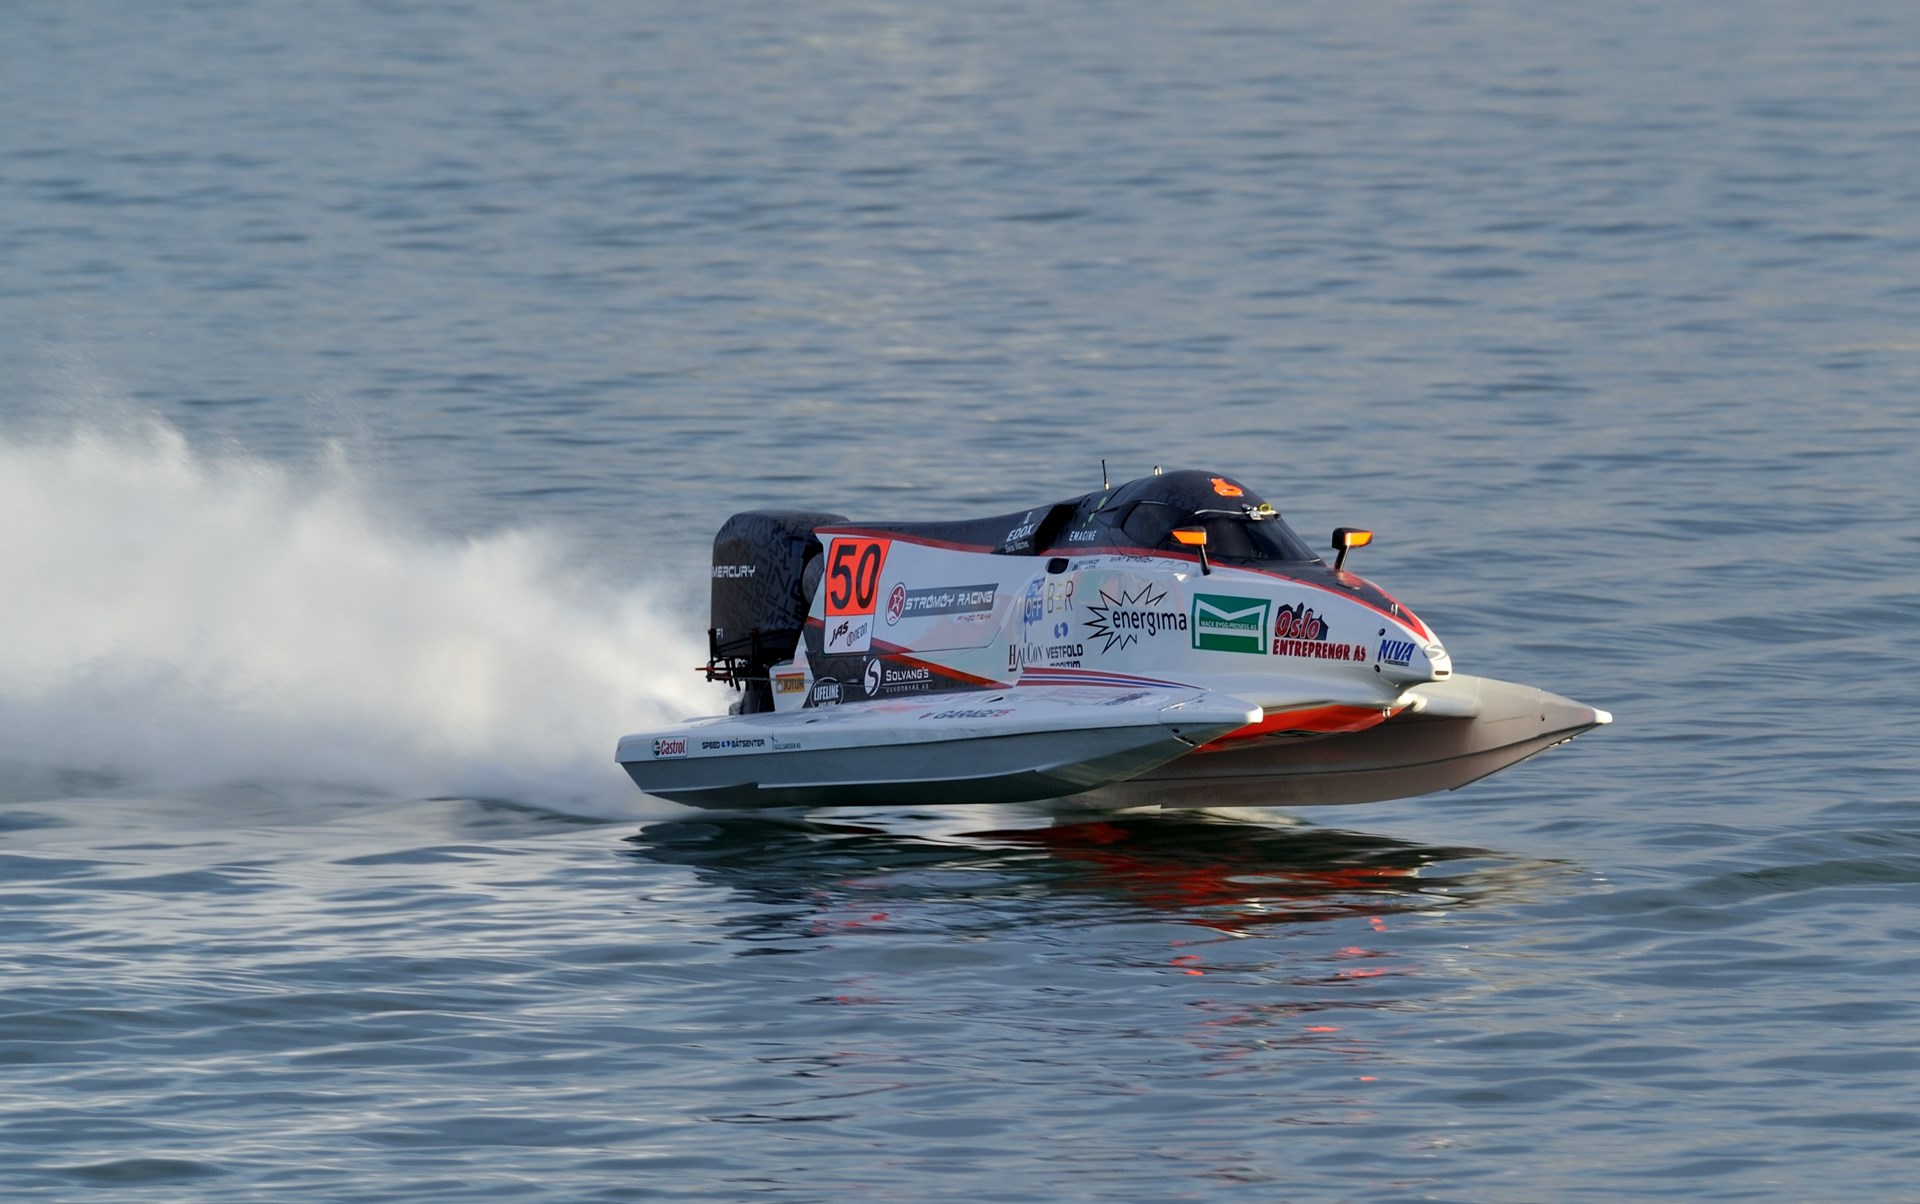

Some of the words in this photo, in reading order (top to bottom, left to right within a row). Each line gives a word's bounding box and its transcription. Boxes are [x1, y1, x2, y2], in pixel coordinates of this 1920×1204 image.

[1006, 523, 1035, 542] EDOX
[1068, 530, 1097, 541] EMAGINE
[712, 565, 756, 578] MERCURY
[830, 544, 881, 610] 50
[905, 592, 955, 611] STRØMØY
[957, 590, 994, 606] RACING
[1113, 610, 1187, 636] energima
[1275, 610, 1321, 639] Oslo
[1046, 644, 1084, 659] VESTFOLD
[1272, 639, 1351, 661] ENTREPRENØR
[1353, 645, 1367, 662] AS
[1378, 640, 1416, 663] NIVA
[885, 667, 930, 682] SOLVANG'S
[813, 684, 840, 701] LIFELINE
[660, 739, 686, 756] Castrol
[702, 740, 721, 750] SPEED
[731, 737, 765, 749] BÅTSENTER
